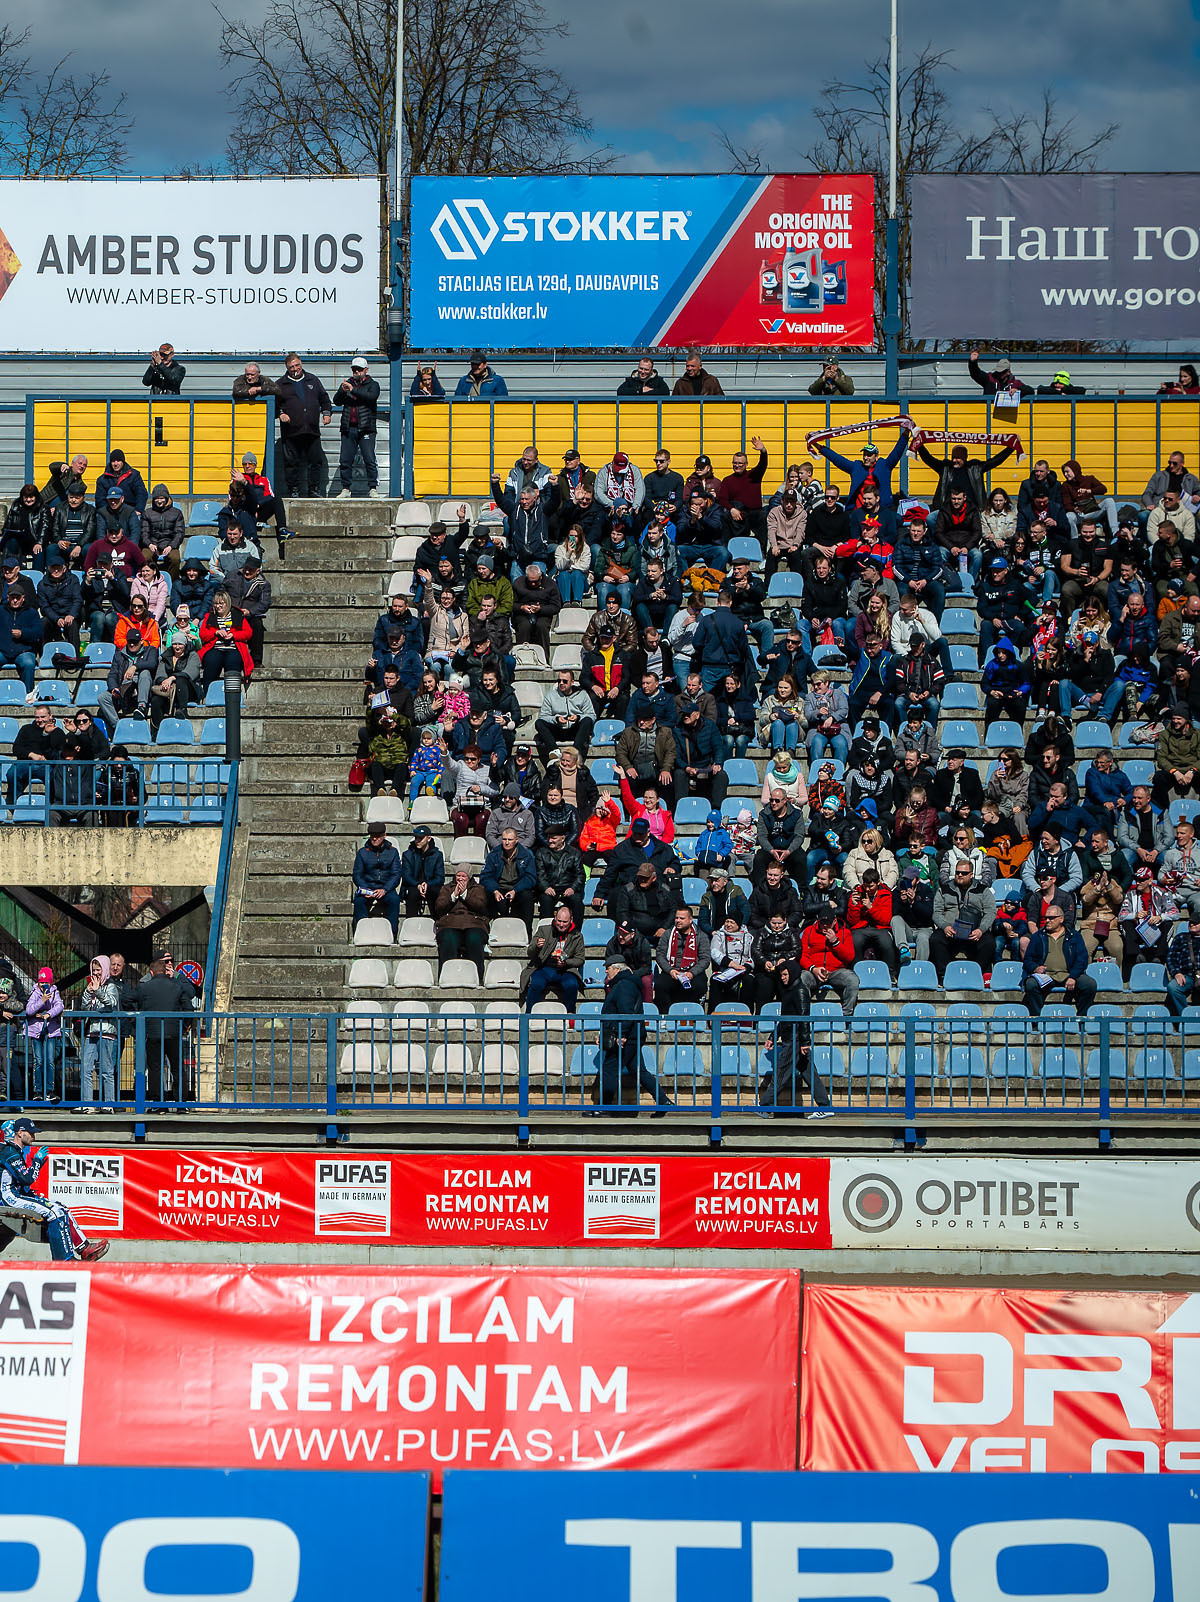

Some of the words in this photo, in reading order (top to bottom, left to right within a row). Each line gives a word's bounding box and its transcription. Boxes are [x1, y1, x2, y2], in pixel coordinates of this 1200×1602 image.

[821, 194, 853, 210] THE
[501, 211, 690, 241] STOKKER
[768, 213, 853, 229] ORIGINAL
[755, 232, 820, 249] MOTOR
[823, 232, 853, 249] OIL
[965, 216, 1109, 261] Наш
[1133, 225, 1200, 261] го
[36, 234, 180, 275] AMBER
[192, 233, 364, 275] STUDIOS
[438, 274, 502, 292] STACIJAS
[506, 274, 534, 292] IELA
[537, 275, 572, 294] 129d,
[575, 273, 659, 292] DAUGAVPILS
[66, 286, 338, 305] WWW.AMBER-STUDIOS.COM
[1041, 287, 1200, 311] www.goro
[437, 303, 548, 321] www.stokker.lv
[154, 416, 168, 447] L
[923, 430, 1014, 446] LOKOMOTIV
[52, 1158, 120, 1179] PUFAS
[176, 1165, 263, 1185] IZCILAM
[319, 1164, 387, 1183] PUFAS
[588, 1167, 656, 1186] PUFAS
[443, 1169, 531, 1188] IZCILAM
[713, 1171, 801, 1191] IZCILAM
[52, 1186, 71, 1195] MADE
[73, 1186, 83, 1195] IN
[85, 1186, 120, 1195] GERMANY
[158, 1190, 281, 1210] REMONTAM
[319, 1191, 339, 1200] MADE
[341, 1192, 350, 1200] IN
[352, 1192, 387, 1201] GERMANY
[588, 1194, 608, 1203] MADE
[610, 1195, 619, 1203] IN
[621, 1195, 656, 1204] GERMANY
[915, 1180, 1080, 1217] OPTIBET
[425, 1194, 549, 1214] REMONTAM
[695, 1197, 819, 1216] REMONTAM
[158, 1212, 280, 1228] WWW.PUFAS.LV
[426, 1217, 549, 1231] WWW.PUFAS.LV
[695, 1219, 819, 1234] WWW.PUFAS.LV
[916, 1219, 1006, 1230] SPORTA
[1023, 1218, 1080, 1230] BĀRS
[308, 1295, 575, 1344] IZCILAM
[248, 1361, 629, 1413] REMONTAM
[903, 1331, 1200, 1431] DR
[248, 1427, 626, 1463] WWW.PUFAS.LV
[565, 1517, 1200, 1602] TRO
